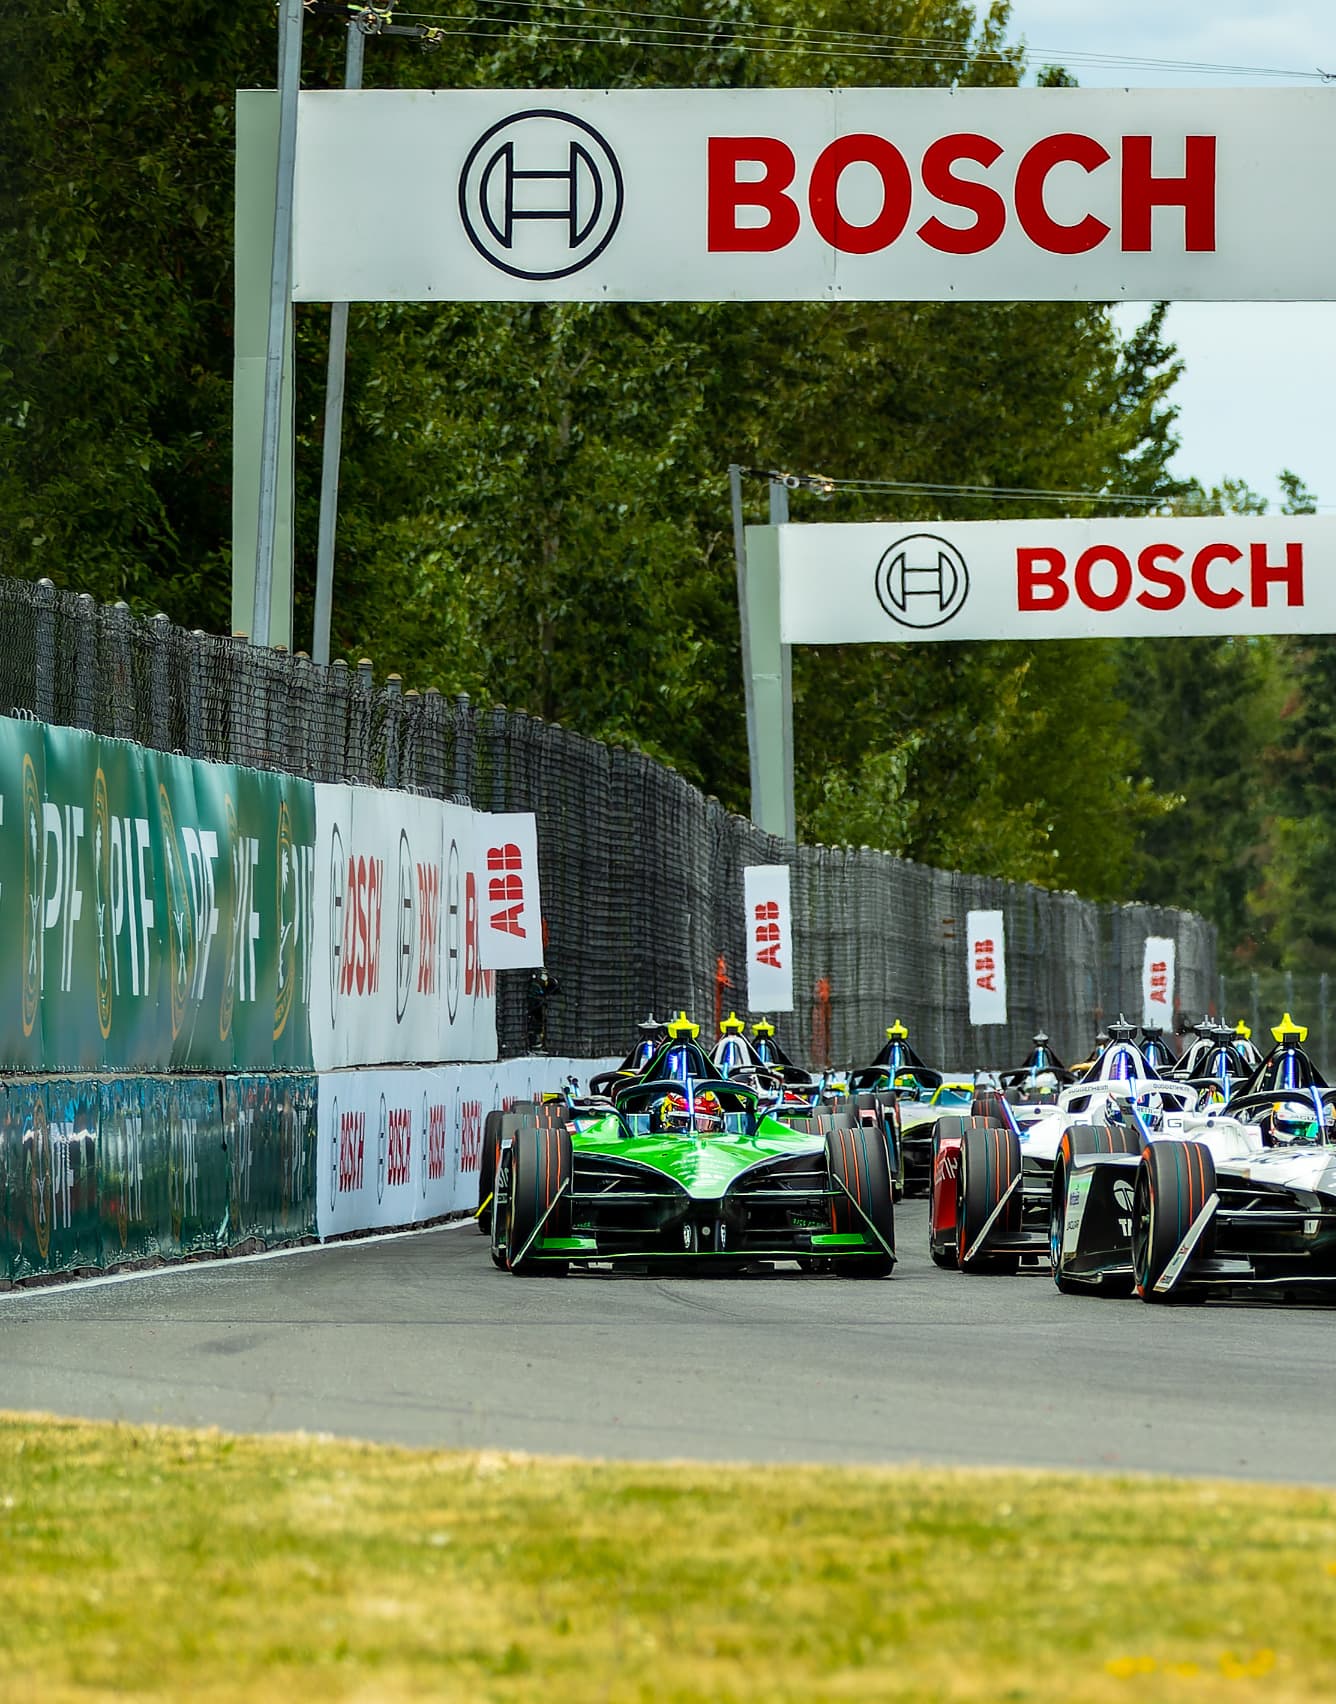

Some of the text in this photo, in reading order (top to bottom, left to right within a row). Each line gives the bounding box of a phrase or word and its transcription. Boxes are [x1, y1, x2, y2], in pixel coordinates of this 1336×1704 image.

[706, 132, 1217, 255] BOSCH
[1015, 542, 1305, 613] BOSCH
[40, 802, 84, 992] PIF
[110, 815, 154, 996] PIF
[340, 855, 384, 997] OSCH
[487, 843, 526, 939] ABB
[755, 901, 782, 969] ABB
[975, 939, 996, 992] ABB
[1150, 961, 1167, 1004] ABB
[339, 1111, 366, 1192] BOSCH
[387, 1108, 412, 1186] BOSCH
